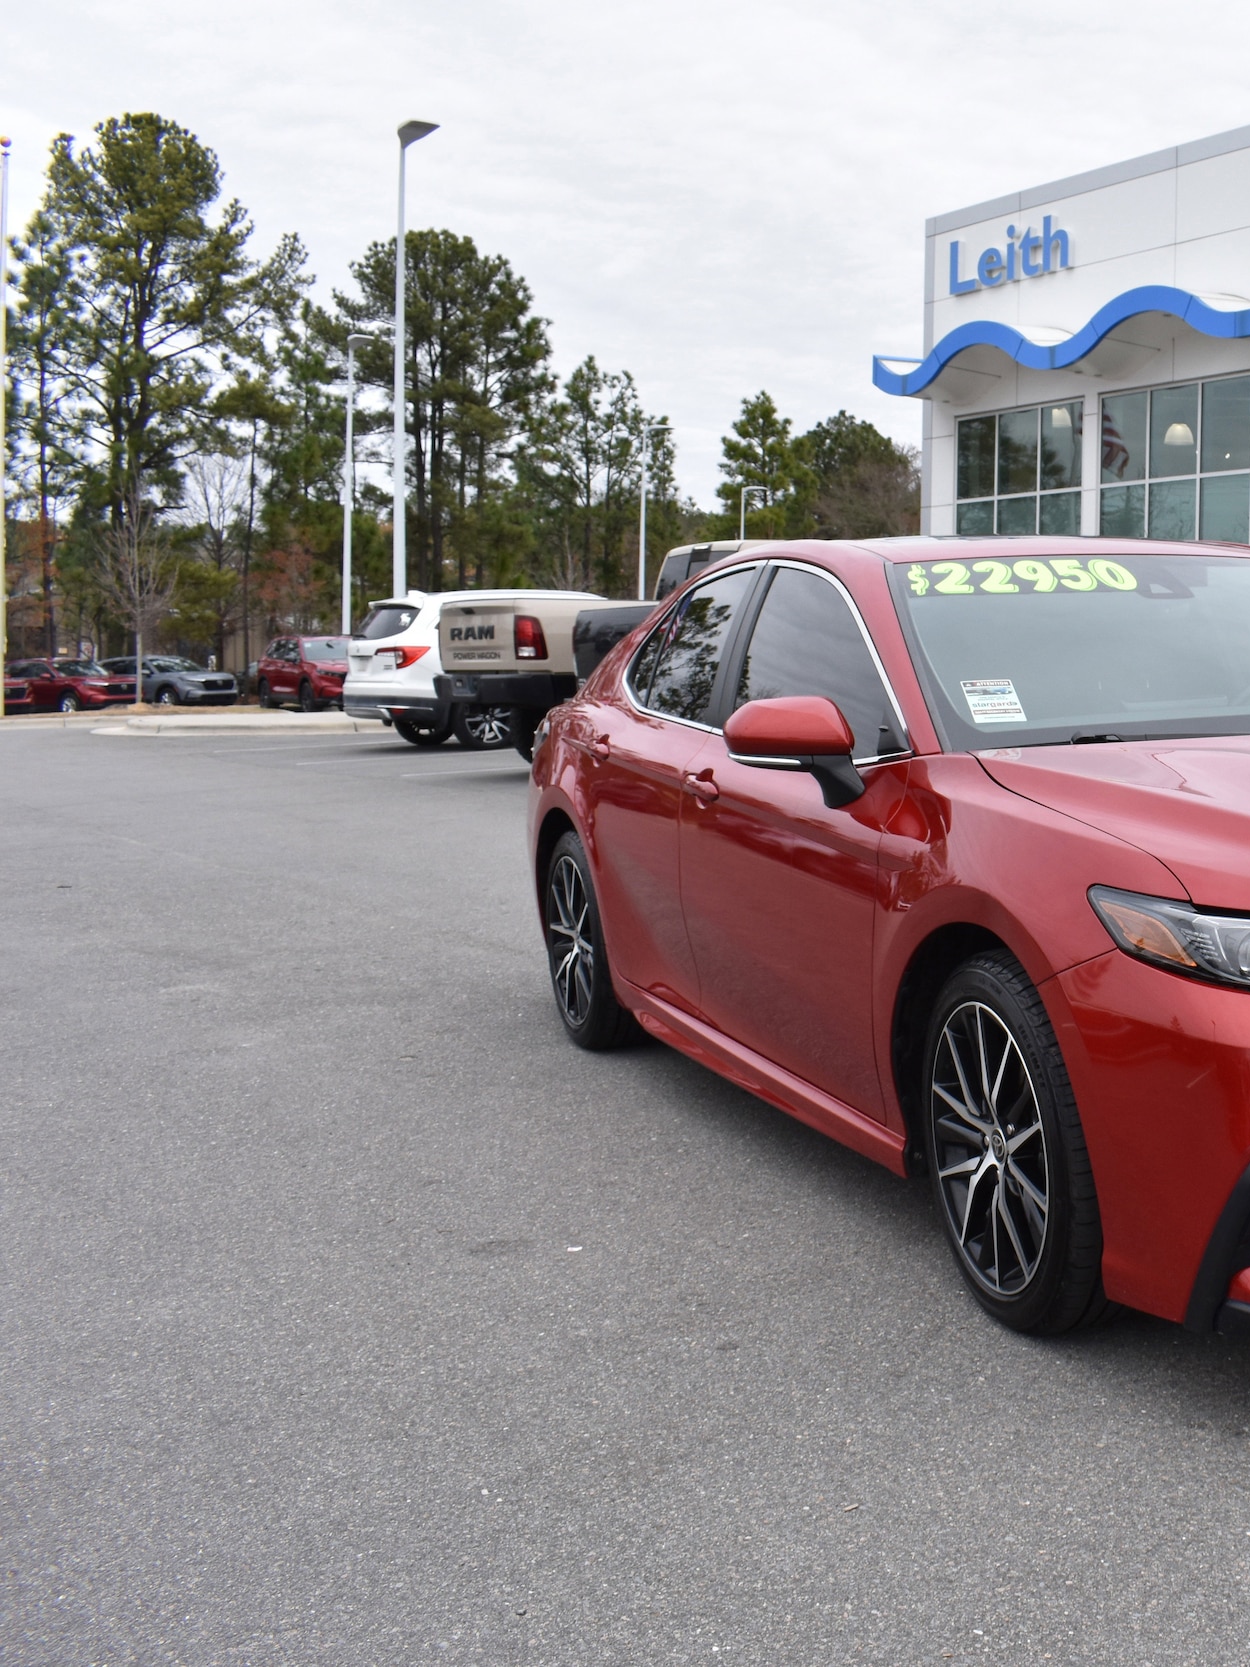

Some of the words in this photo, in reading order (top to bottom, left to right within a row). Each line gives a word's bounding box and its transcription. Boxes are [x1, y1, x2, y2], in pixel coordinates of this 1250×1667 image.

[949, 214, 1072, 295] Leith
[908, 558, 1138, 596] $22950
[450, 625, 495, 641] RAM
[453, 652, 476, 660] POWER
[477, 651, 501, 660] WAGON
